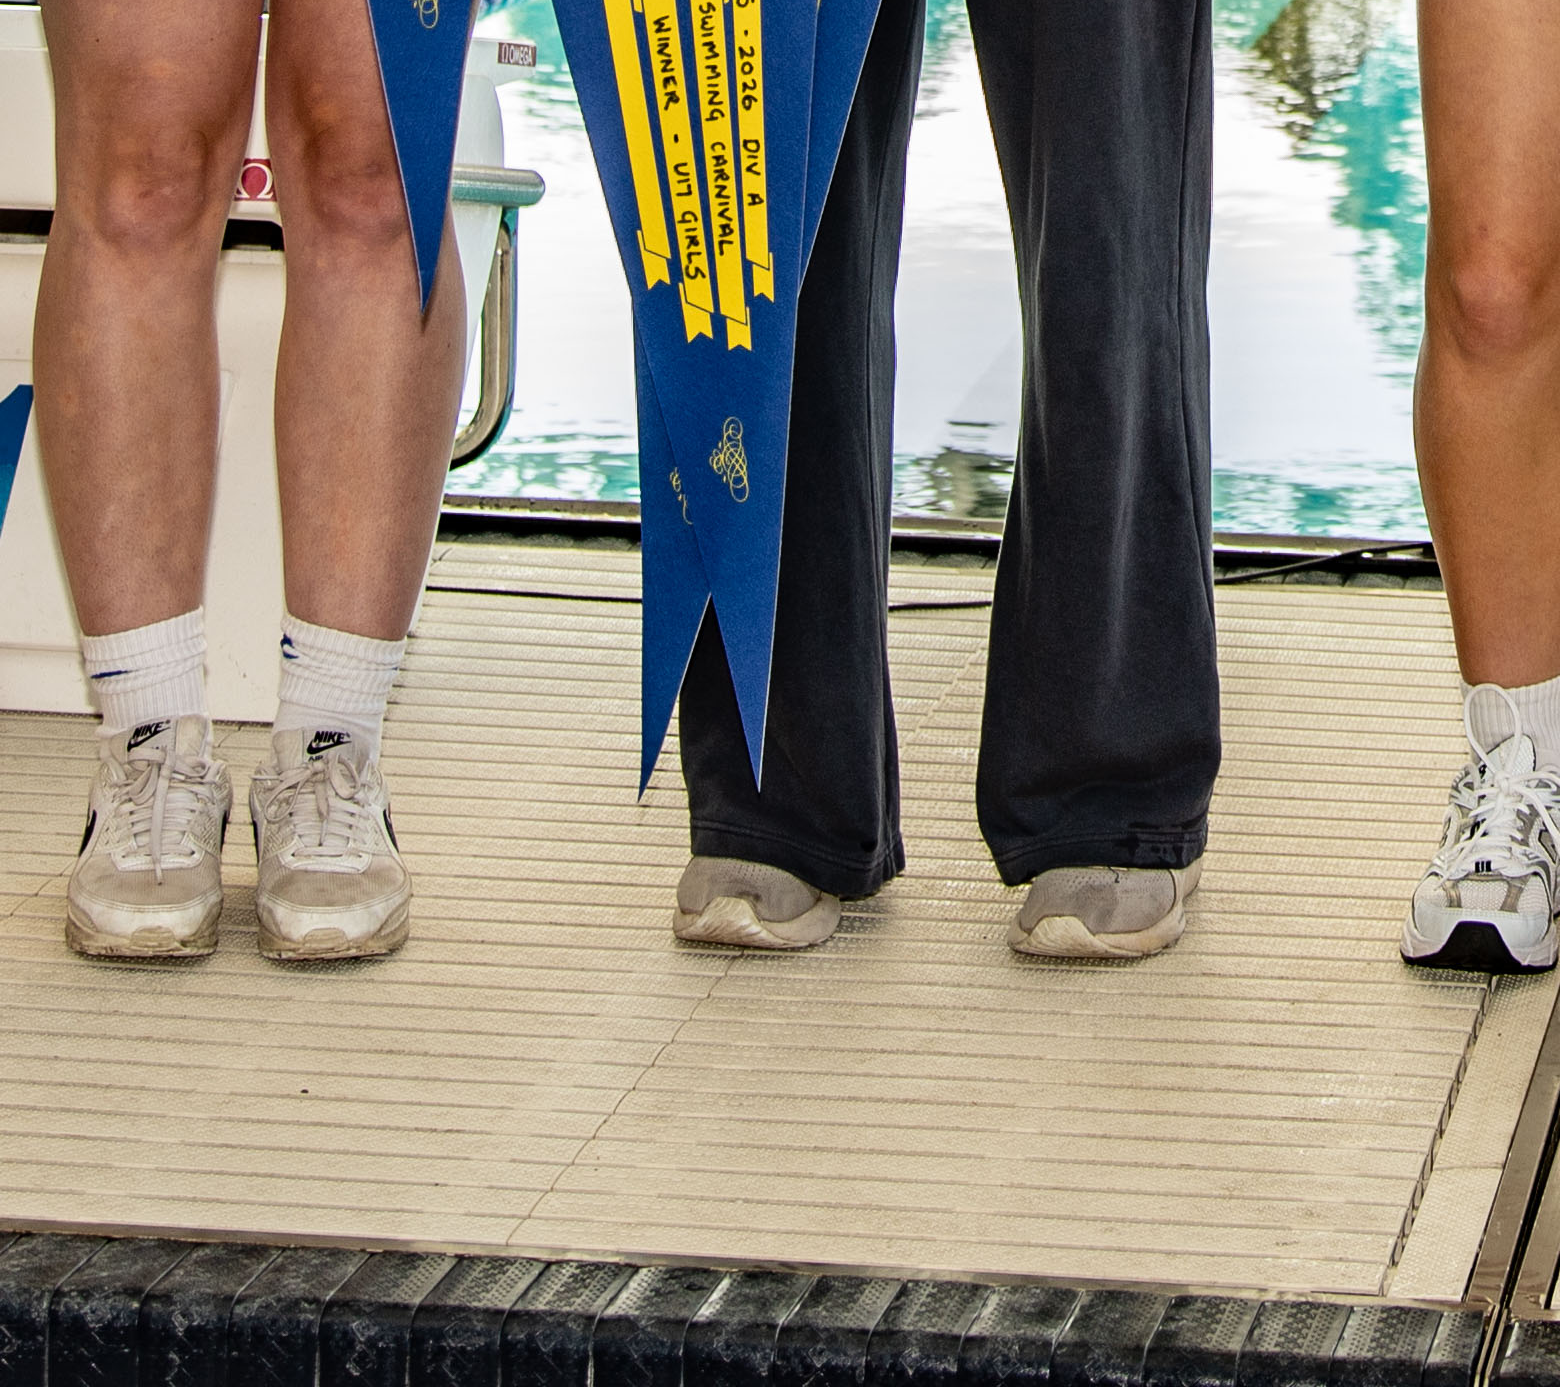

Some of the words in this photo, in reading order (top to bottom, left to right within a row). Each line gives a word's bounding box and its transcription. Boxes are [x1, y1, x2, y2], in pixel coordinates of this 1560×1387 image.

[699, 1, 725, 122] SWIMMING
[738, 45, 758, 111] 2026
[653, 15, 680, 111] WINNER
[677, 209, 706, 281] GIRLS
[742, 138, 761, 176] DIV
[710, 140, 734, 256] CARNIVAL
[747, 192, 765, 207] A
[132, 720, 164, 739] NIKE
[313, 731, 346, 744] NIKE
